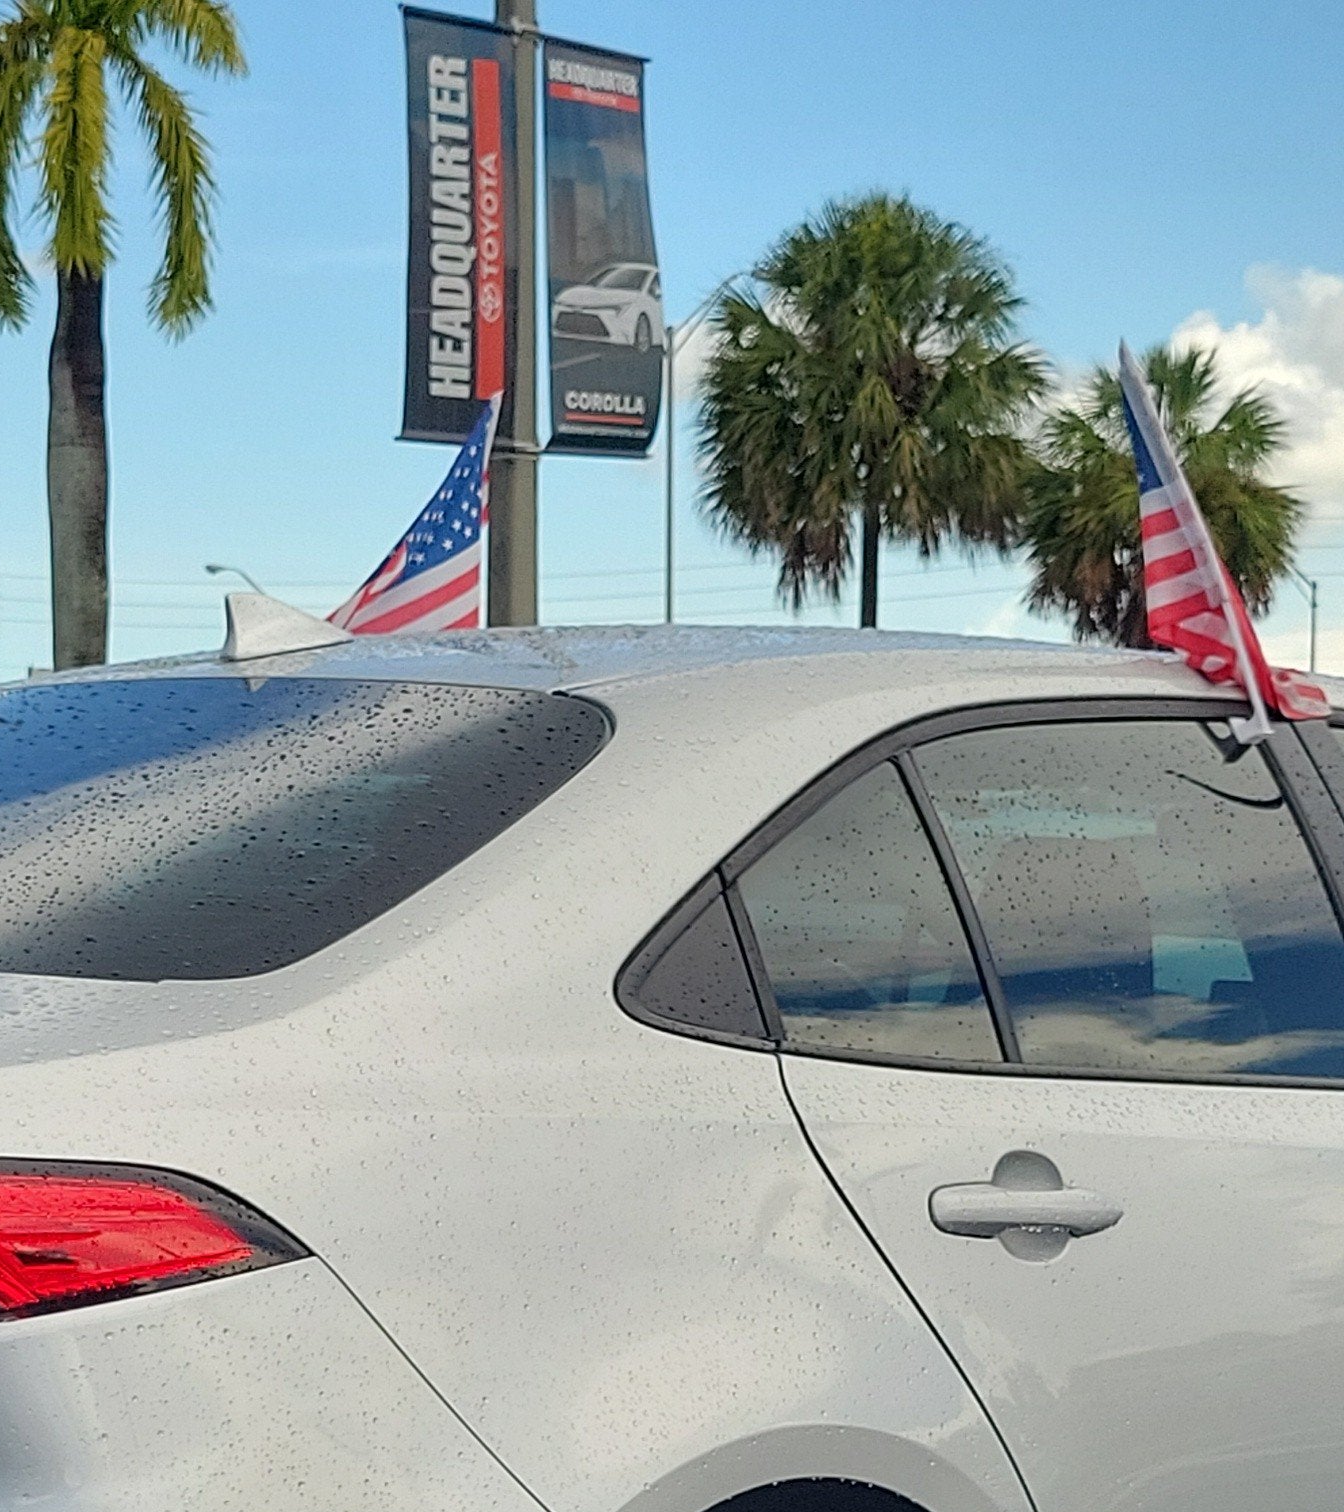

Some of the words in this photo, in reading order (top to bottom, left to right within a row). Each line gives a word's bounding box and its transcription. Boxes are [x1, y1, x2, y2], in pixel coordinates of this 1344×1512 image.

[428, 56, 476, 399] HEADQUARTER
[479, 153, 500, 280] TOYOTA
[565, 391, 646, 415] COROLLA
